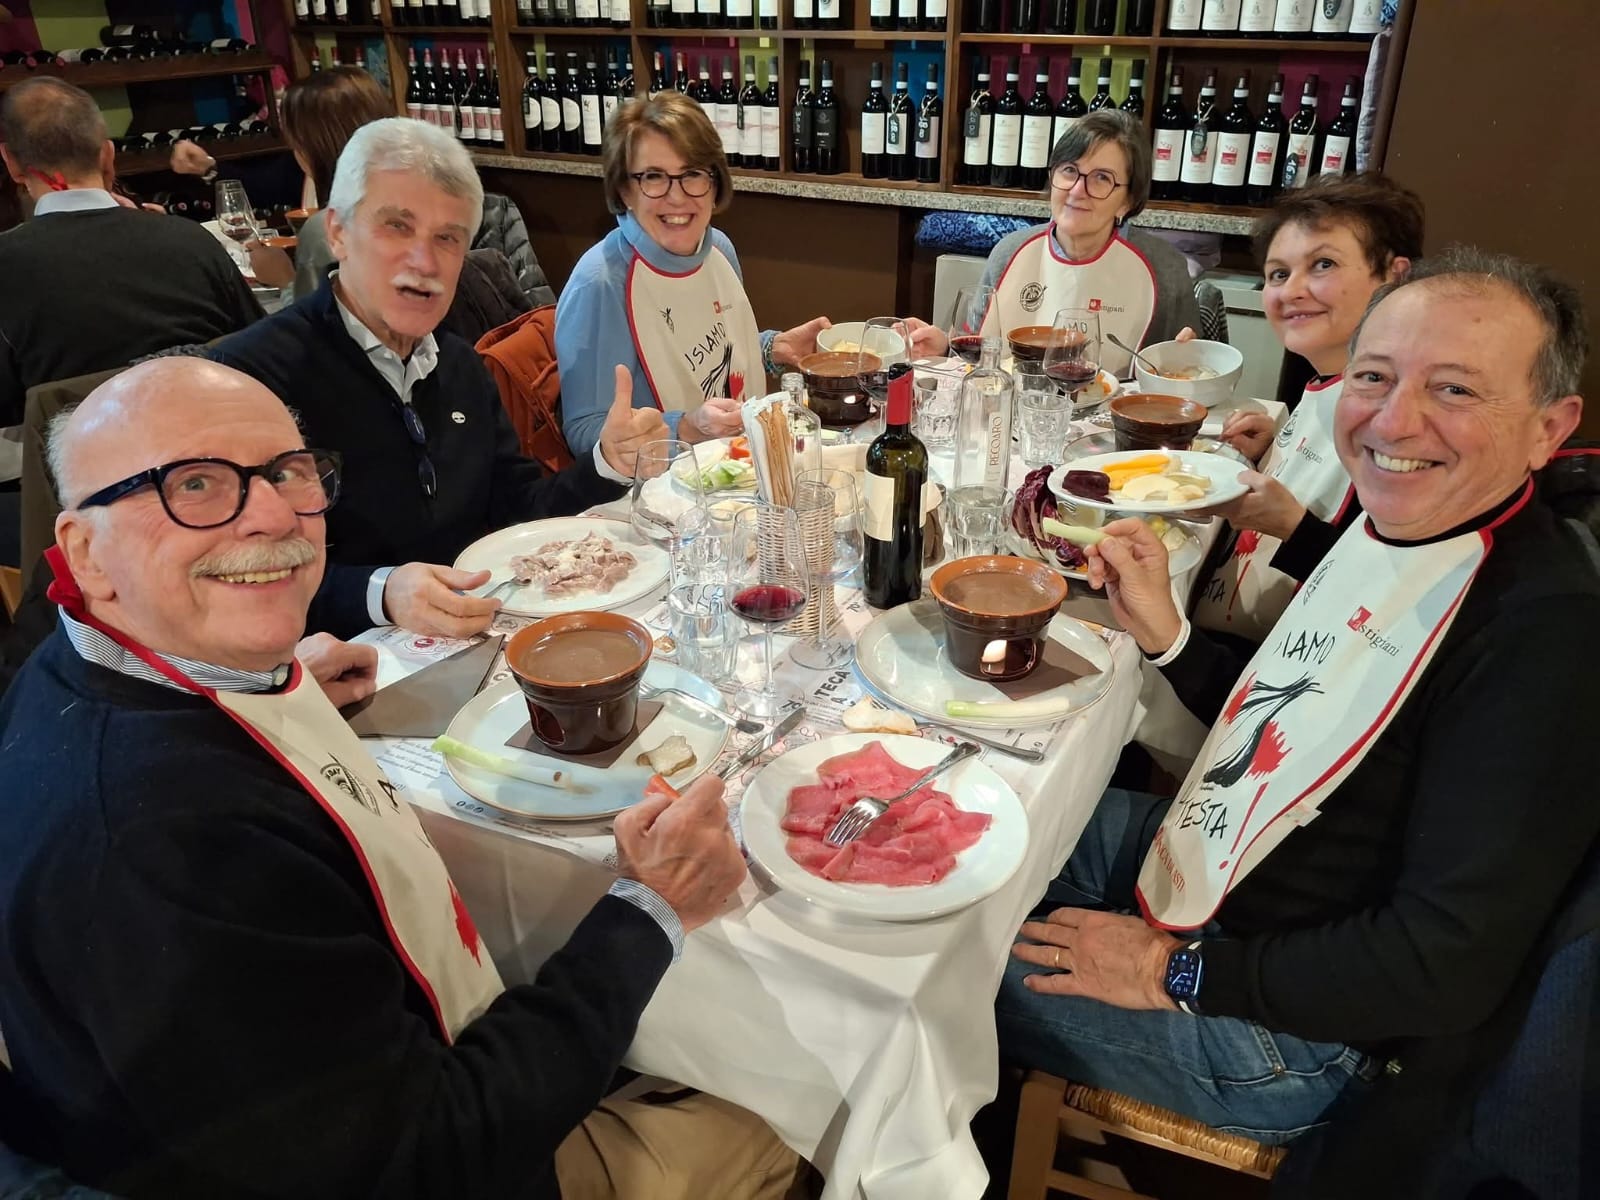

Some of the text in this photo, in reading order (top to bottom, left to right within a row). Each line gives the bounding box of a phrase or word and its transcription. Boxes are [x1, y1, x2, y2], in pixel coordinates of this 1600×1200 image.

[989, 416, 1002, 466] RECOARO
[1273, 629, 1336, 665] IAMO
[813, 670, 851, 699] TECA
[1174, 798, 1228, 840] TESTA
